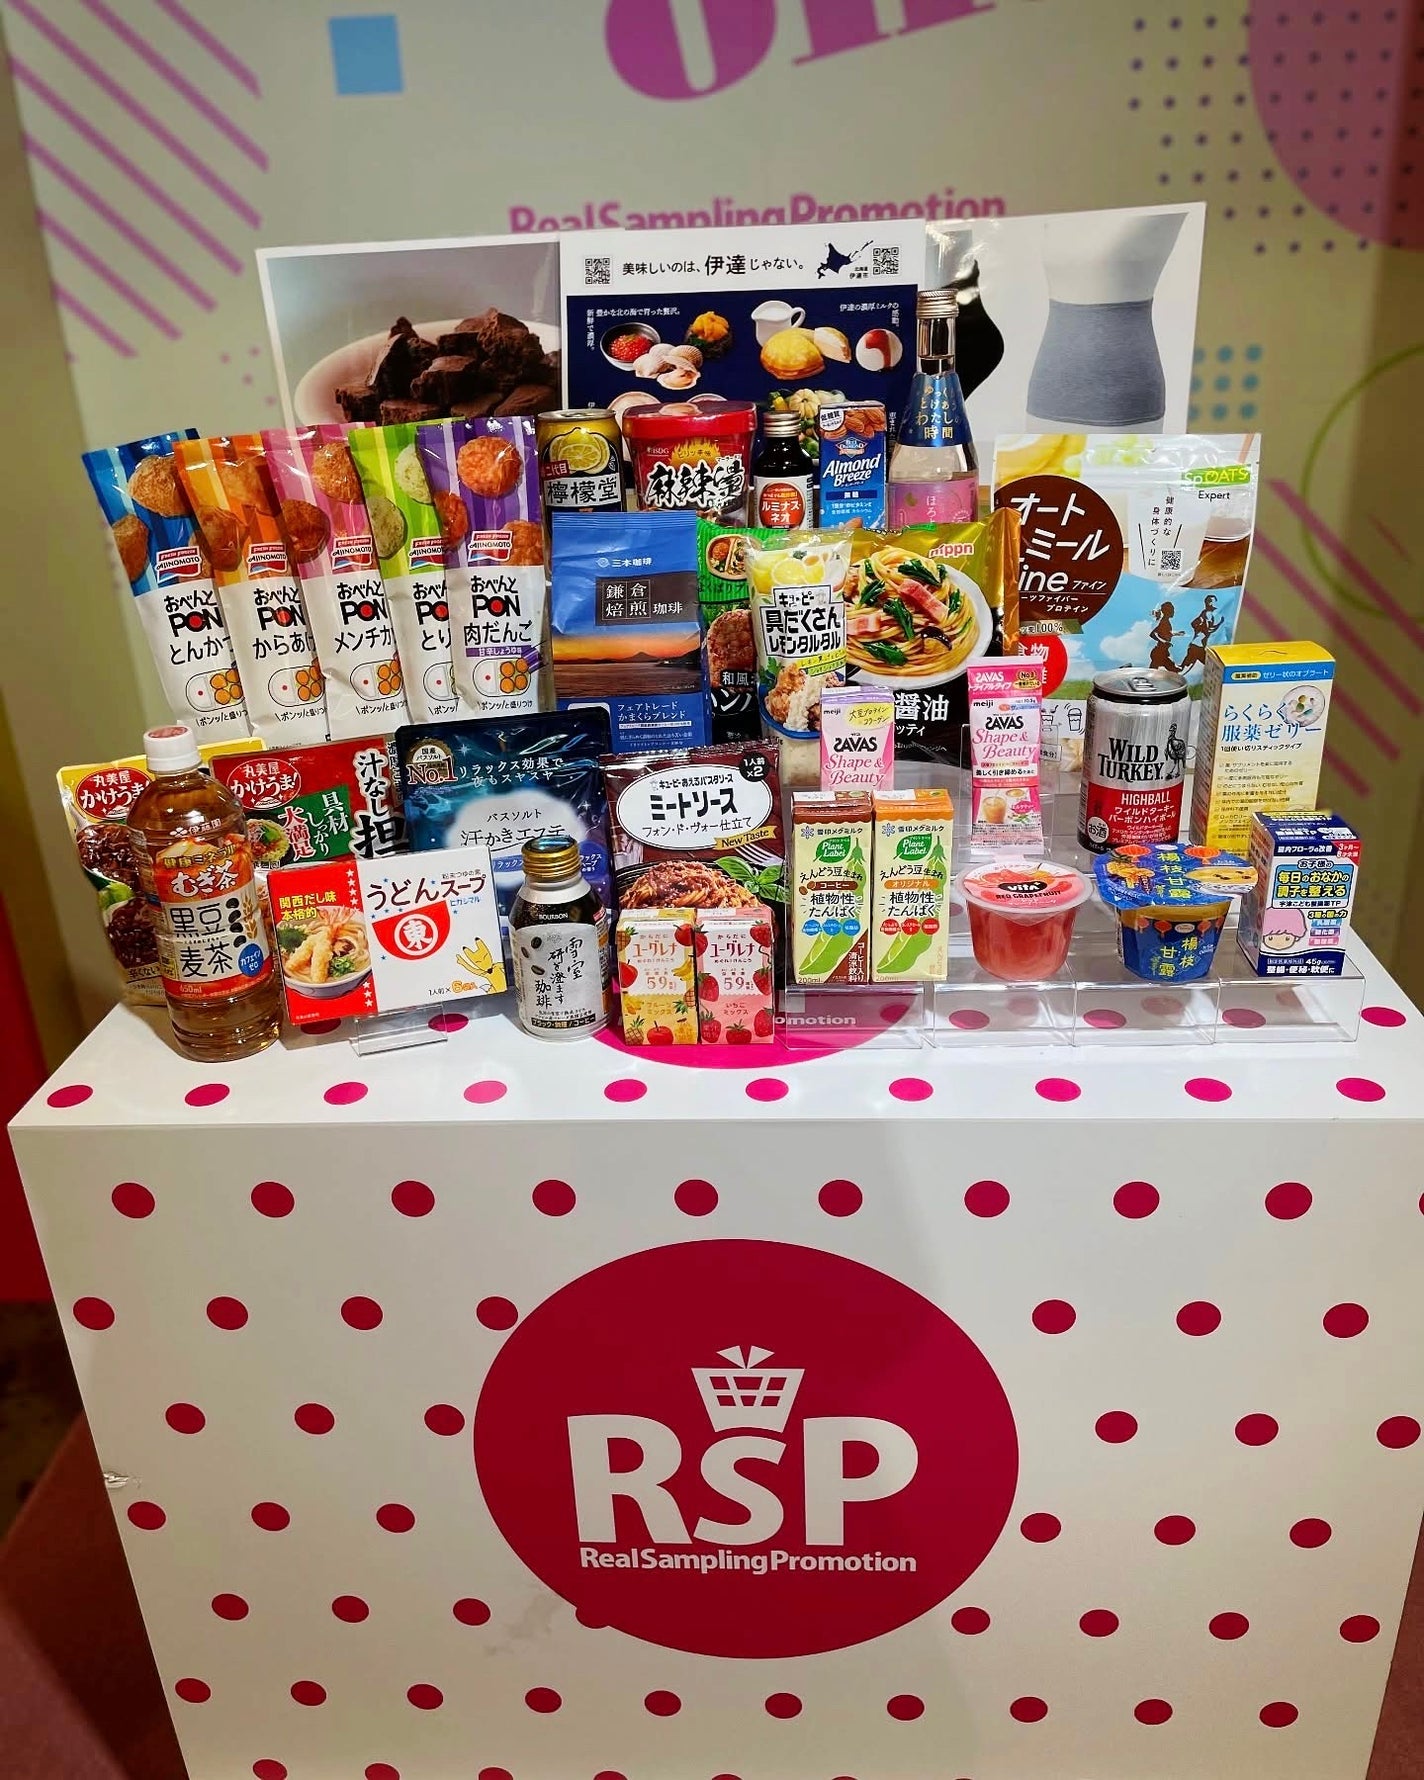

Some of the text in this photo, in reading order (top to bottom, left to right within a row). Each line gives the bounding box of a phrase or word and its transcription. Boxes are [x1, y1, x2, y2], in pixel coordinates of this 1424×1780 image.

[623, 254, 805, 277] 美味しいのは、伊達じゃない。
[924, 425, 953, 439] 時間
[546, 463, 568, 476] 二代目
[822, 453, 882, 478] Almond
[833, 470, 872, 487] Breeze
[547, 476, 618, 504] 檸檬堂
[1198, 490, 1230, 502] Expert
[762, 501, 800, 511] ルミナス
[1010, 491, 1086, 526] オート
[771, 513, 790, 522] ネオ
[1163, 496, 1174, 536] 健康的な
[1148, 506, 1160, 566] 身体づくりに
[332, 546, 372, 557] AJINOMOTO
[469, 541, 511, 549] AJINOMOTO
[929, 543, 975, 558] nippn
[1025, 528, 1110, 562] ミール
[156, 556, 200, 570] AJINOMOTO
[248, 553, 287, 563] AJINOMOTO
[470, 574, 518, 594] おべんと
[1018, 563, 1107, 592] ine ファイン
[253, 585, 300, 606] おべんと
[336, 579, 384, 599] おべんと
[606, 582, 647, 600] 鎌倉
[164, 589, 218, 613] おべんと
[472, 594, 521, 619] PON
[1020, 594, 1079, 603] ーツファイバー
[340, 598, 388, 625] PON
[606, 601, 683, 617] 焙煎 珈琲
[1046, 603, 1089, 613] プロテイン
[168, 606, 224, 637] PON
[257, 605, 306, 631] PON
[765, 606, 841, 633] 具だくさん
[463, 619, 533, 646] 肉だんご
[769, 631, 841, 654] レモンタルタル
[975, 671, 1004, 683] SAVAS
[1263, 669, 1329, 679] ゼリー状のオブラート
[617, 700, 678, 711] フェアトレード
[895, 692, 950, 721] 醤油
[973, 700, 994, 708] meiji
[1224, 702, 1287, 721] らくらく
[617, 710, 686, 722] かまくらブレンド
[849, 707, 888, 721] 大豆プロテイン
[864, 716, 891, 726] コラーゲン
[985, 716, 1024, 730] SAVAS
[972, 728, 1028, 745] Shape &
[1221, 723, 1322, 742] 服薬ゼリー
[833, 736, 877, 752] SAVAS
[983, 744, 1037, 760] Beauty
[1108, 737, 1158, 763] WILD
[1221, 742, 1302, 753] 1回使い切りスティックタイプ
[241, 762, 281, 778] 丸美屋
[406, 756, 458, 785] No.1
[460, 756, 564, 778] リラックス効果で
[743, 757, 765, 767] 1人前
[825, 753, 884, 771] Shape &
[92, 769, 132, 788] 丸美屋
[230, 771, 299, 799] かけうま!
[473, 771, 554, 788] 夜もスヤスヤ
[830, 769, 884, 787] Beauty
[650, 787, 738, 821] ミートソース
[1121, 791, 1171, 806] HIGHBALL
[322, 791, 349, 835] 具材
[486, 808, 542, 822] バスソルト
[1108, 811, 1177, 824] バーボンハイボール
[1114, 804, 1174, 815] ワイルドターキー
[188, 818, 221, 835] 伊藤園
[278, 806, 316, 861] 大満足
[306, 812, 329, 856] しっかり
[642, 817, 752, 838] フォン・ド・ヴォー仕立て
[817, 827, 863, 836] 雪印メグミルク
[898, 825, 945, 833] 雪印メグミルク
[1088, 823, 1107, 838] お酒
[721, 828, 769, 847] New Taste
[821, 842, 844, 850] Plant
[902, 839, 925, 848] Plant
[164, 844, 236, 868] 健康ミネラル
[823, 848, 847, 857] Label
[903, 846, 927, 855] Label
[1299, 859, 1332, 868] お子様の
[170, 859, 239, 897] むぎ茶
[799, 866, 864, 884] えんどう豆生まれ
[880, 864, 944, 881] えんどう豆生まれ
[1278, 870, 1349, 883] 毎日のおなかの
[366, 873, 487, 910] うどんスープ
[820, 881, 850, 889] コーヒー
[893, 880, 930, 888] オリジナル
[1277, 885, 1346, 898] 調子を整える
[279, 890, 337, 909] 関西だし味
[810, 892, 855, 905] 植物性
[890, 891, 935, 904] 植物性
[1012, 890, 1061, 899] GRAPEFRUIT
[281, 906, 317, 921] 本格的
[809, 905, 856, 918] たんぱく
[888, 904, 935, 917] たんぱく
[169, 902, 226, 938] 黒豆
[402, 919, 433, 950] 東
[632, 939, 678, 957] ユーグレナ
[709, 939, 755, 958] ユーグレナ
[1179, 935, 1198, 968] 楊枝
[179, 941, 233, 977] 麦茶
[240, 949, 260, 966] カフェイン
[857, 941, 865, 981] コーヒー入り
[1159, 945, 1177, 977] 甘露
[248, 962, 259, 971] ゼロ
[535, 979, 552, 1009] 珈琲
[646, 1001, 672, 1009] フルーツ
[723, 1008, 749, 1016] ミックス
[567, 1413, 919, 1546] RSP
